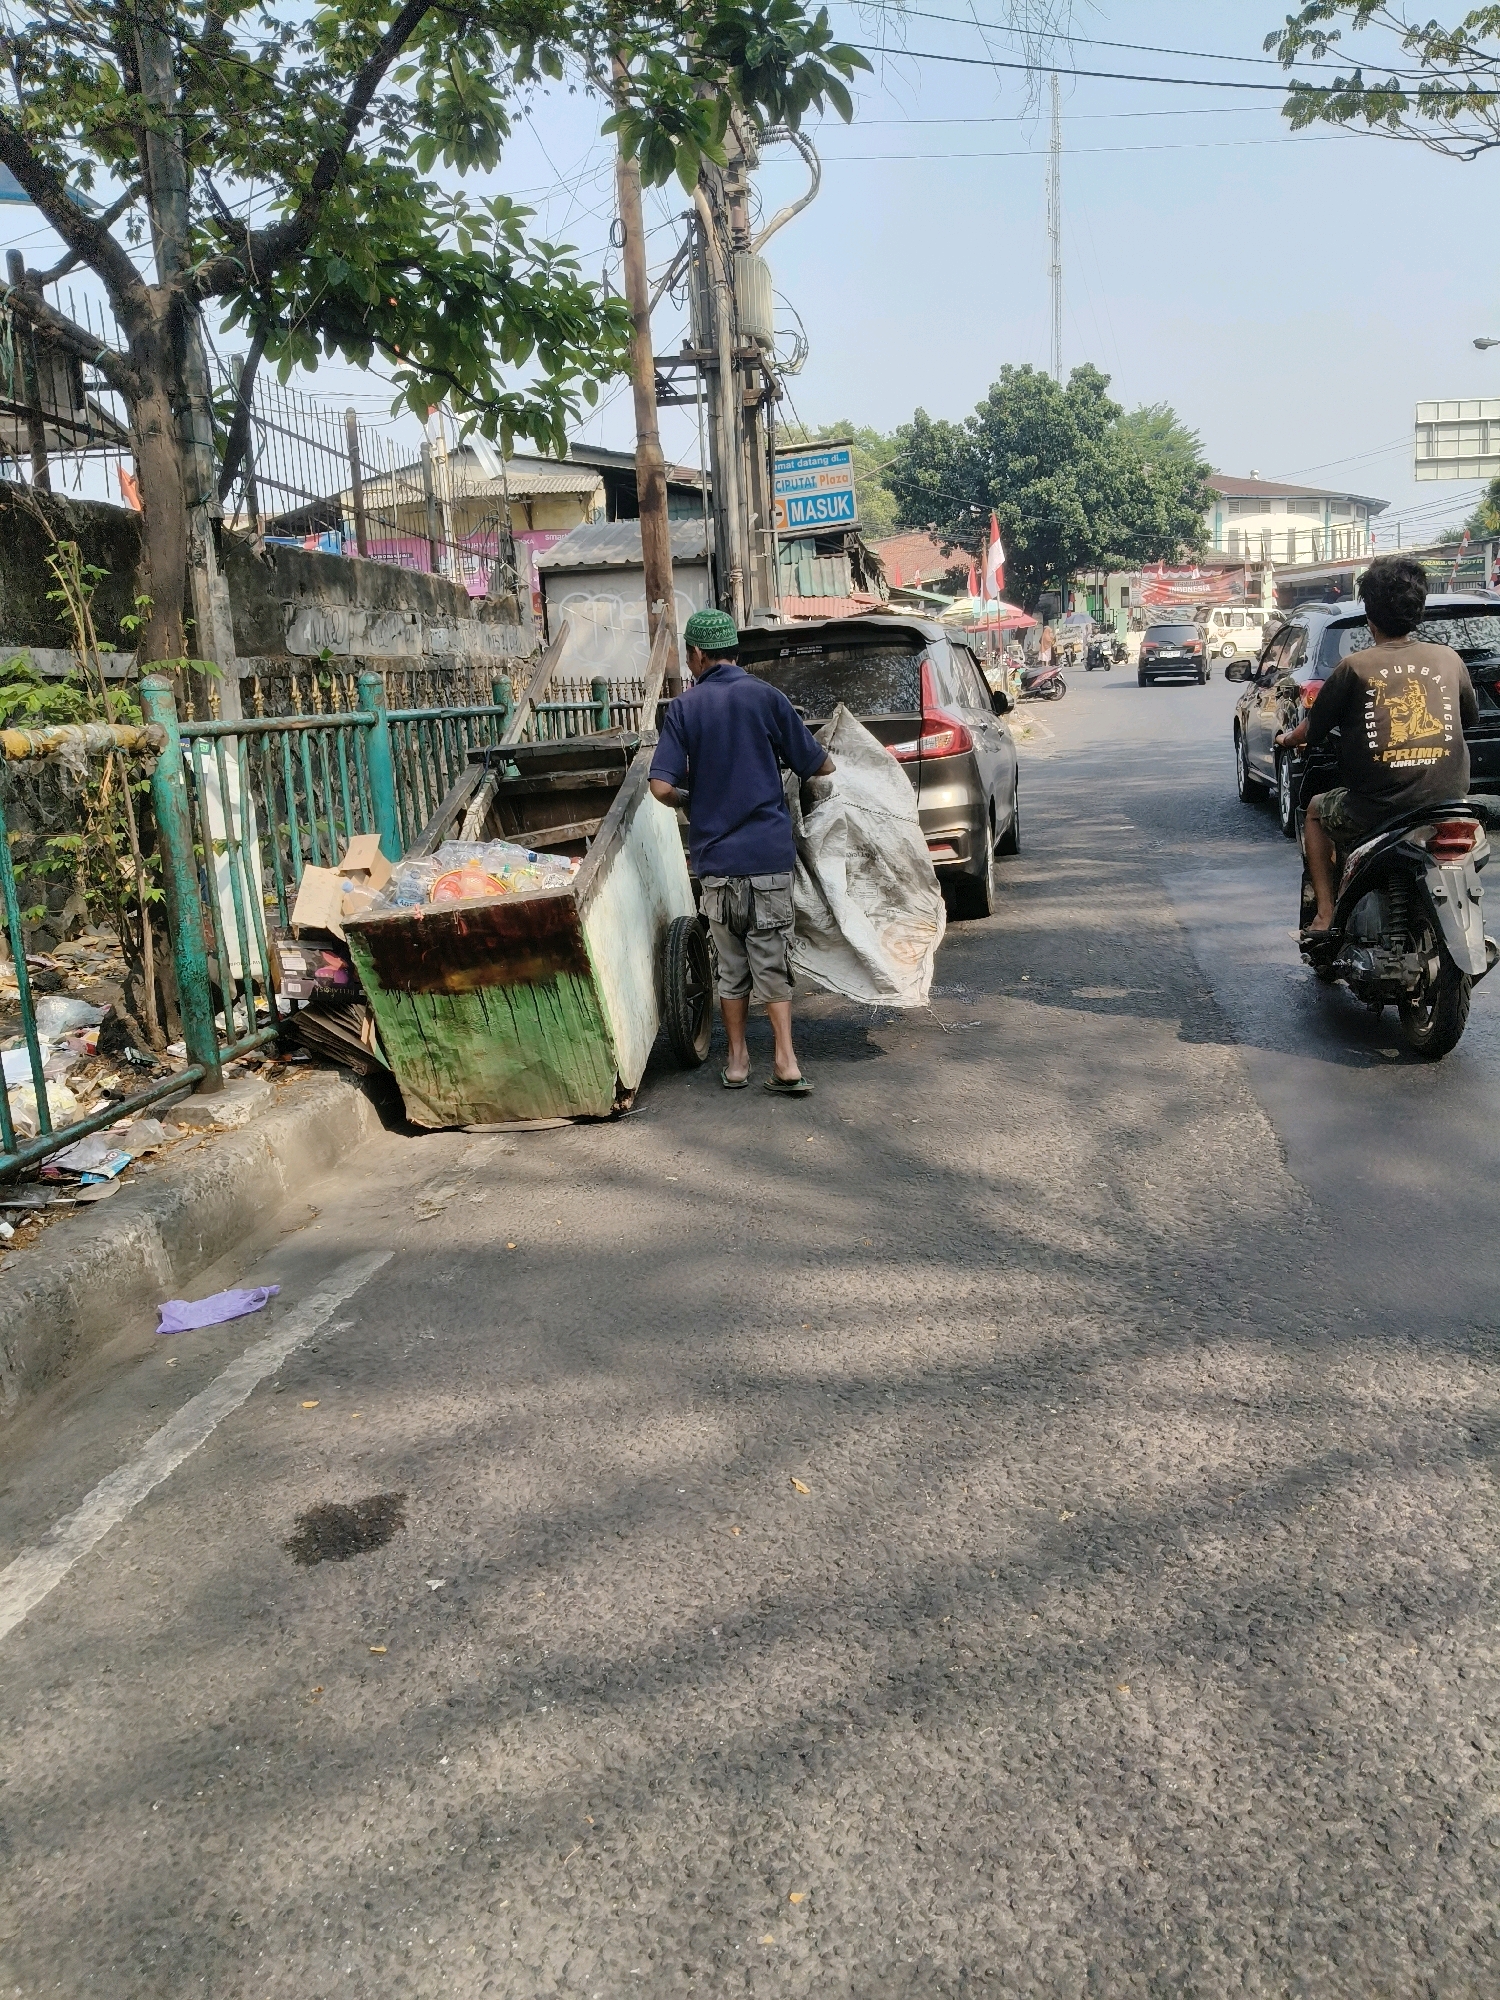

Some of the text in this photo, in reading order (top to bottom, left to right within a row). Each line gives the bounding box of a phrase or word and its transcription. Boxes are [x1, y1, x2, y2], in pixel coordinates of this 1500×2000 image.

[797, 457, 829, 468] datang
[775, 473, 849, 493] CIPUTAT Plaza
[790, 494, 851, 523] MASUK
[1364, 664, 1453, 749] PESONA PURBALINGGA
[1382, 747, 1444, 762] PRIMA
[1389, 757, 1437, 768] KNALPOT
